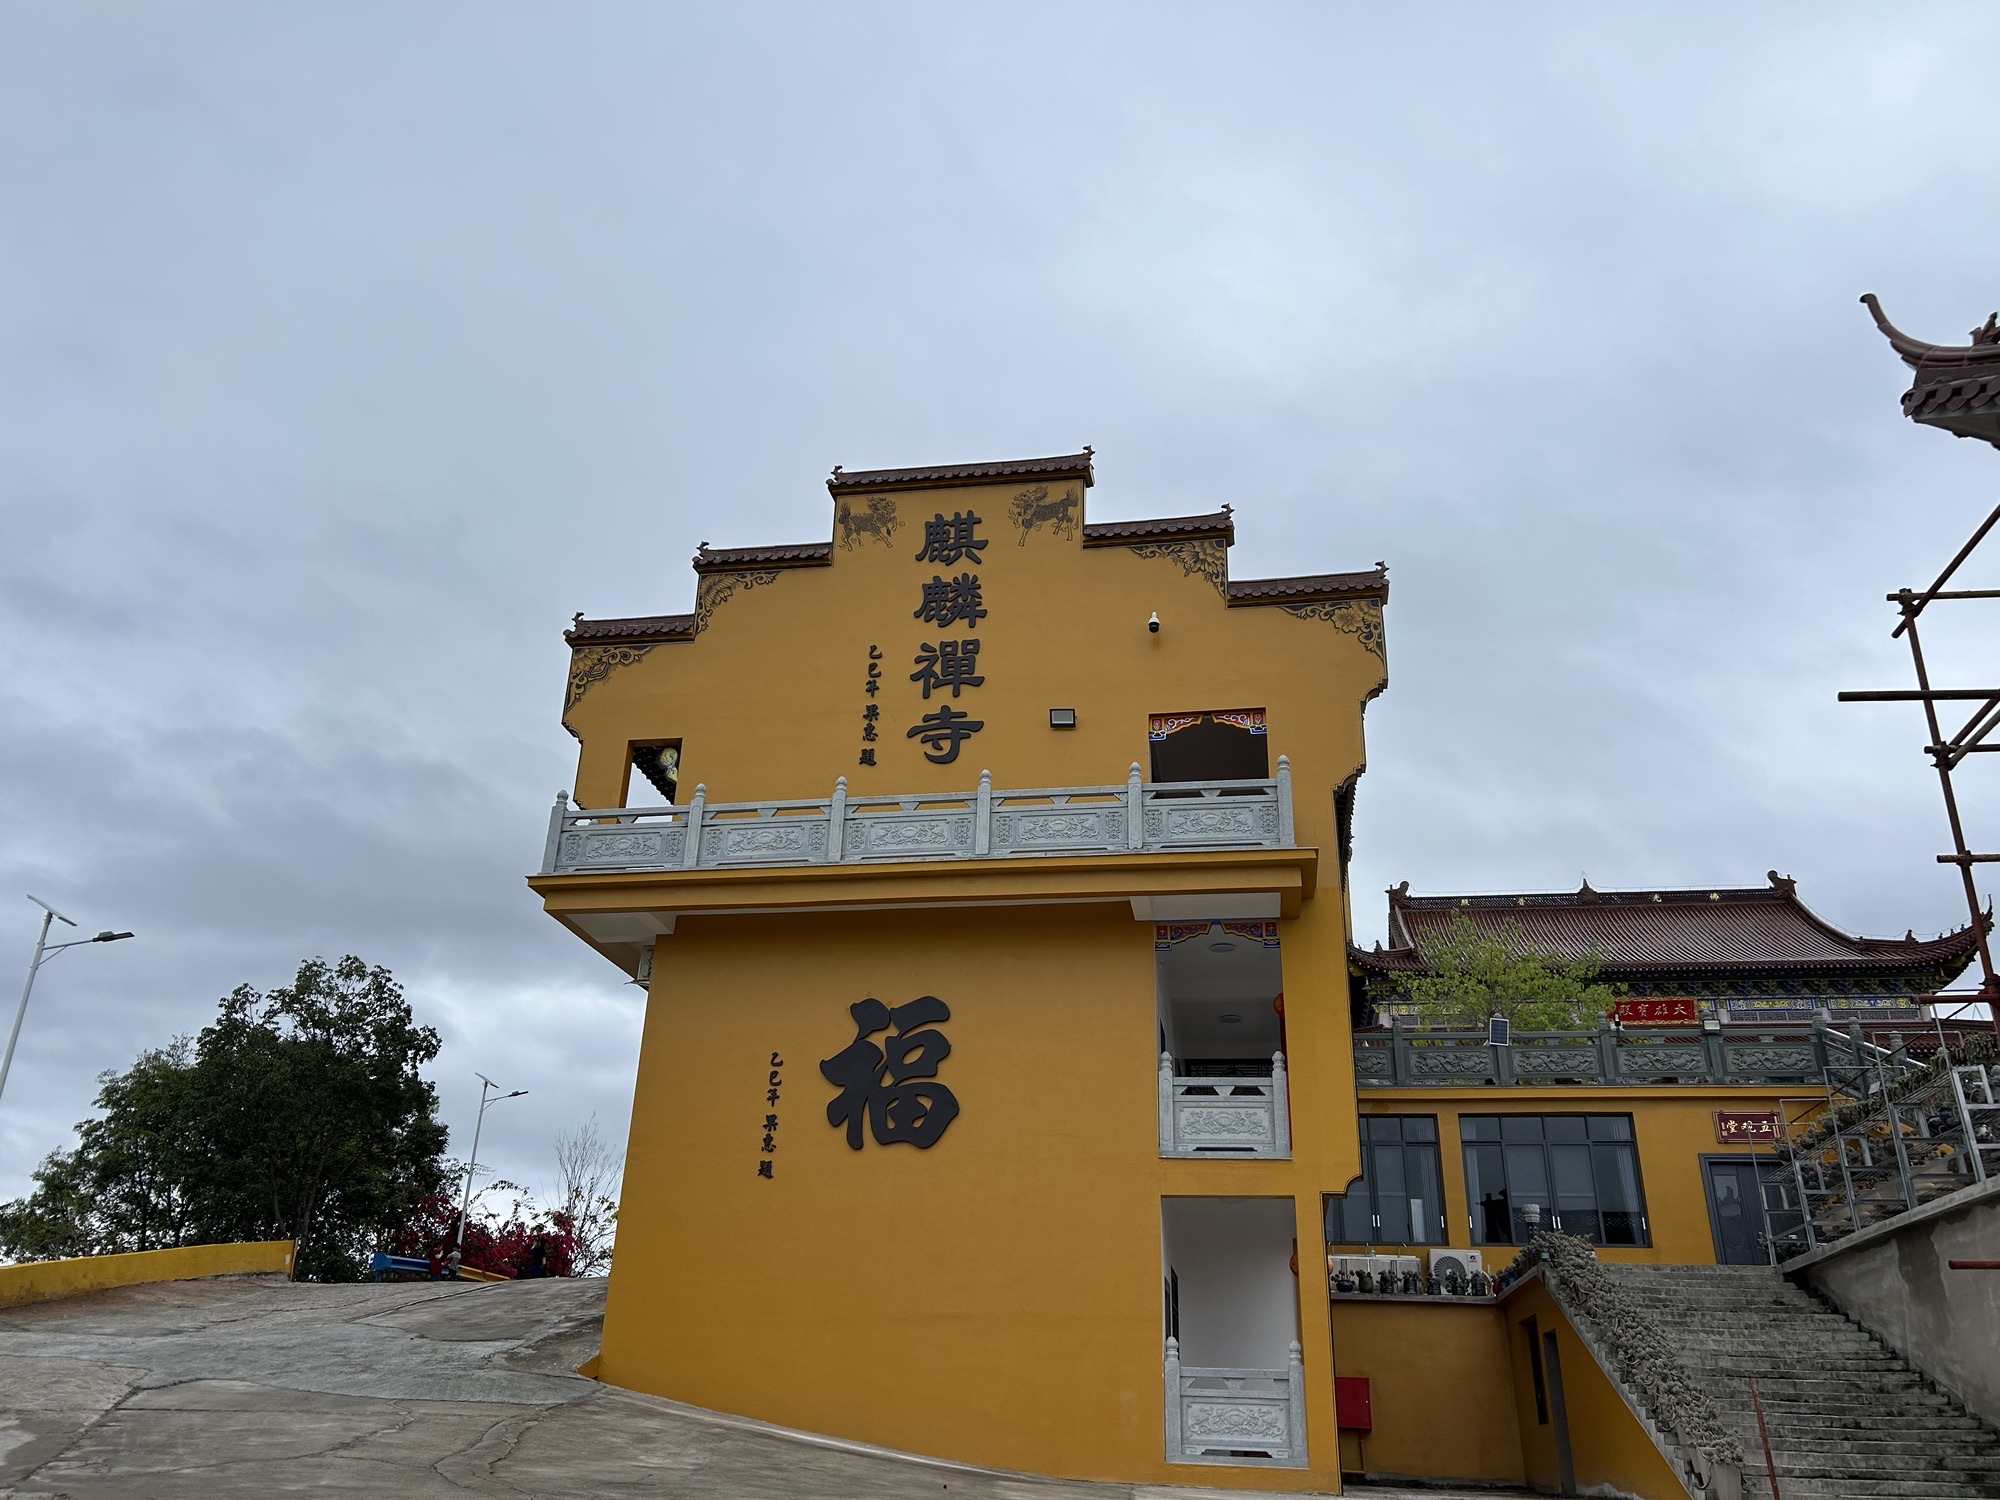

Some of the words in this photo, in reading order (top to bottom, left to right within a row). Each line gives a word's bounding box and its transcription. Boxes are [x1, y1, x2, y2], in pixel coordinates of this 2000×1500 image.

[906, 509, 989, 765] 麒麟禪寺
[818, 995, 961, 1152] 福
